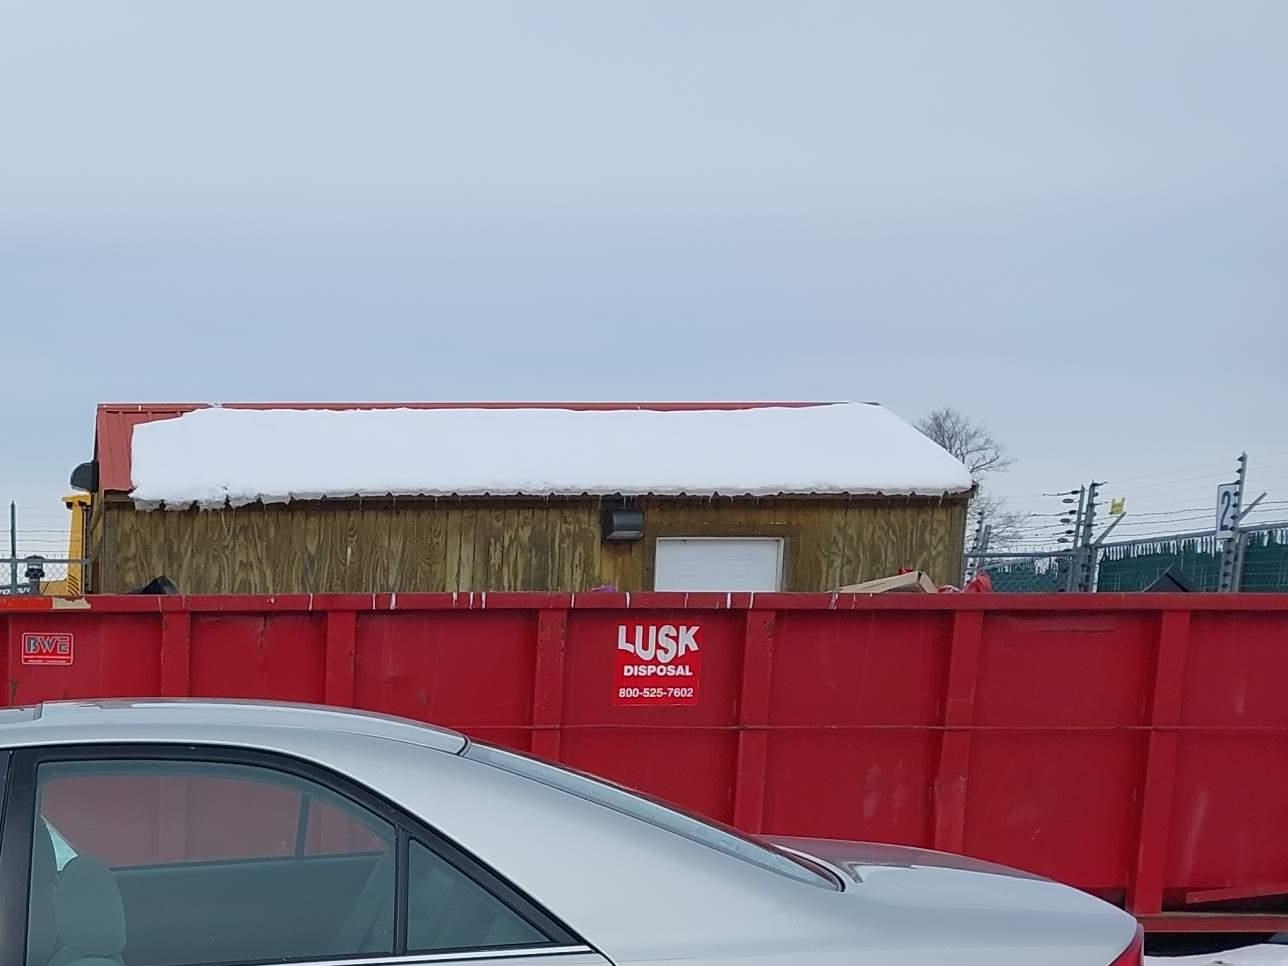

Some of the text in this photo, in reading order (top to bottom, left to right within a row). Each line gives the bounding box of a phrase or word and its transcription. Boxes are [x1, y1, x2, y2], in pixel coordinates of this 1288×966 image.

[25, 635, 70, 654] BWE
[618, 625, 700, 663] LUSK
[623, 665, 693, 676] DISPOSAL
[618, 687, 694, 698] 800-525-7602
